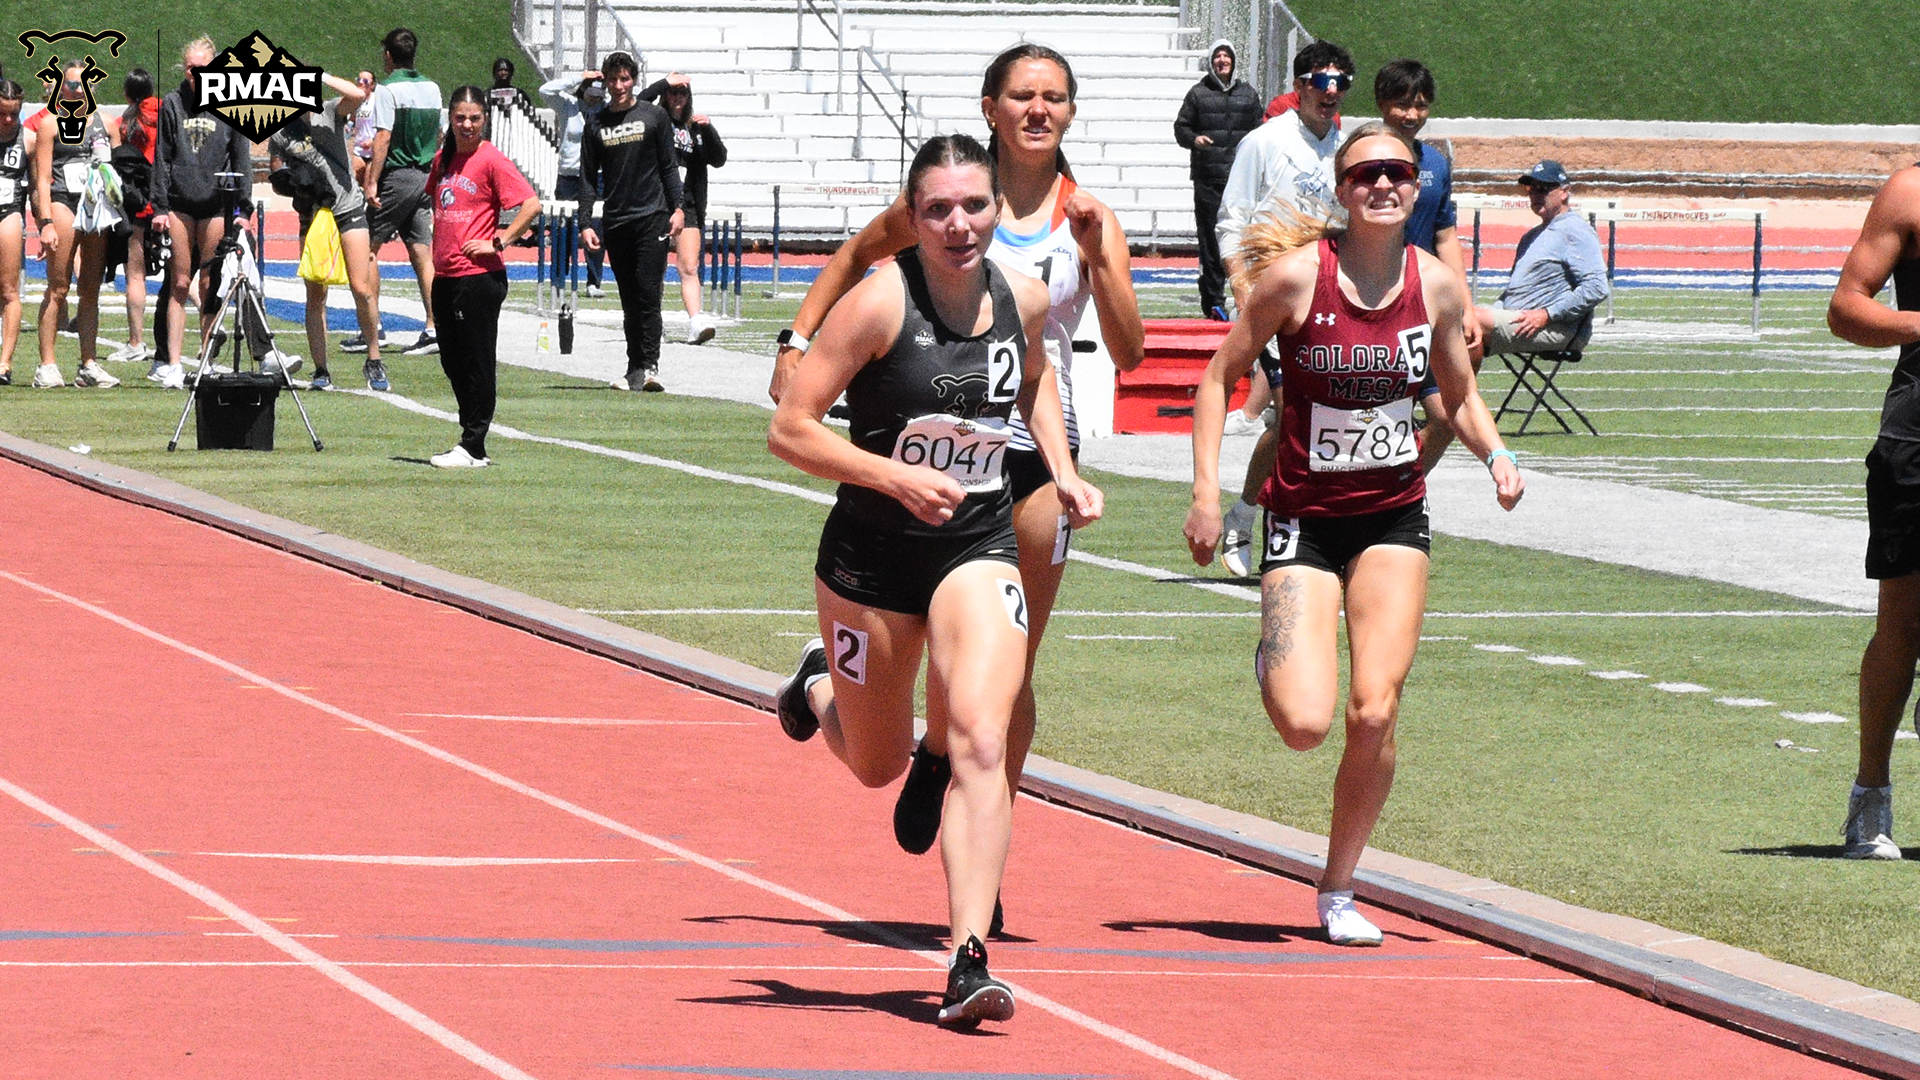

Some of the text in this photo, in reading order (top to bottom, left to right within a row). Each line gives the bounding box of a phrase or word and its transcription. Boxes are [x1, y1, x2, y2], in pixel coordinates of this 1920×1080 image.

[600, 120, 646, 141] UCCS
[620, 134, 644, 144] COUNTRY
[7, 149, 17, 166] 6
[819, 186, 879, 194] THUNDERWOLVES
[1641, 210, 1710, 221] THUNDERWOLVES
[1033, 255, 1053, 288] 1
[1406, 330, 1428, 378] 5
[993, 347, 1015, 397] 2
[1328, 376, 1408, 402] MESA
[900, 433, 1006, 474] 6047
[1316, 420, 1412, 462] 5782
[1062, 523, 1072, 558] 1
[1269, 514, 1291, 556] 5
[1005, 583, 1028, 631] 2
[837, 629, 860, 680] 2
